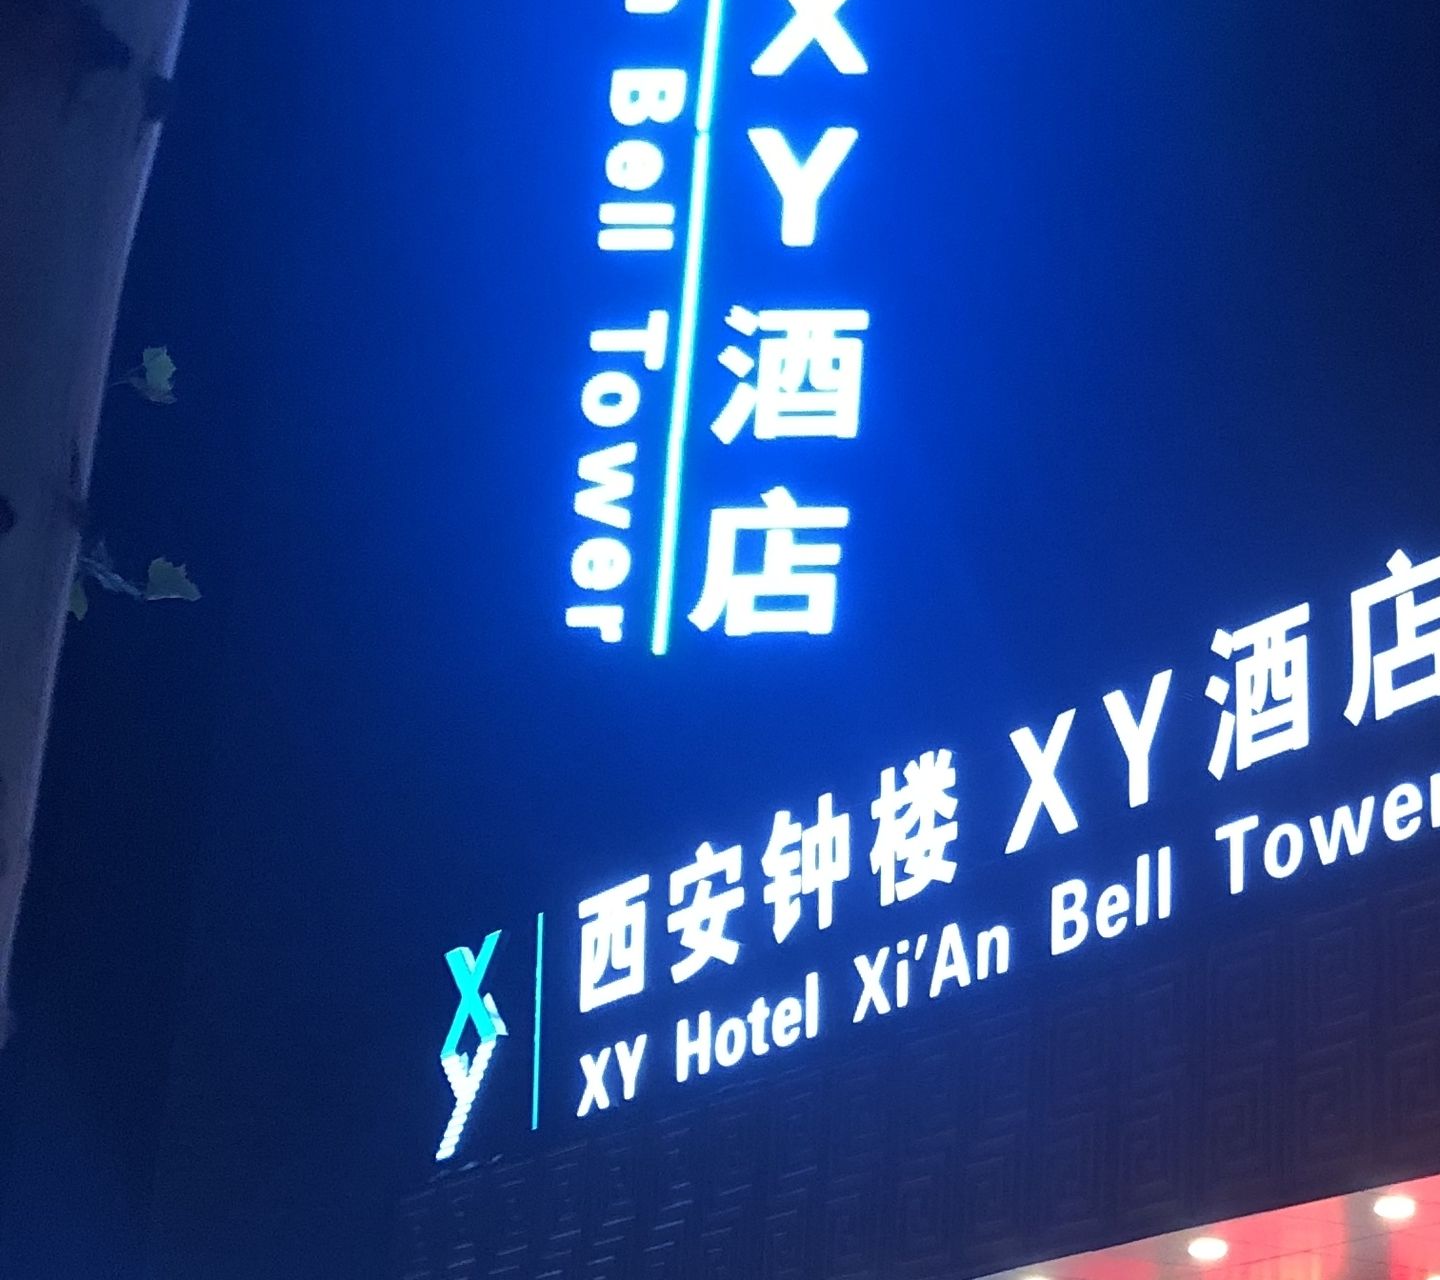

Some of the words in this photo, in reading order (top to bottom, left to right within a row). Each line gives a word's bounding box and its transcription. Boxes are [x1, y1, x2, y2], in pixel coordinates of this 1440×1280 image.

[596, 66, 688, 252] Bell
[565, 309, 670, 644] Tower
[576, 1033, 648, 1117] XY
[675, 970, 820, 1083] Hotel
[852, 921, 1010, 1024] Xi'An
[1049, 845, 1173, 957] Bell
